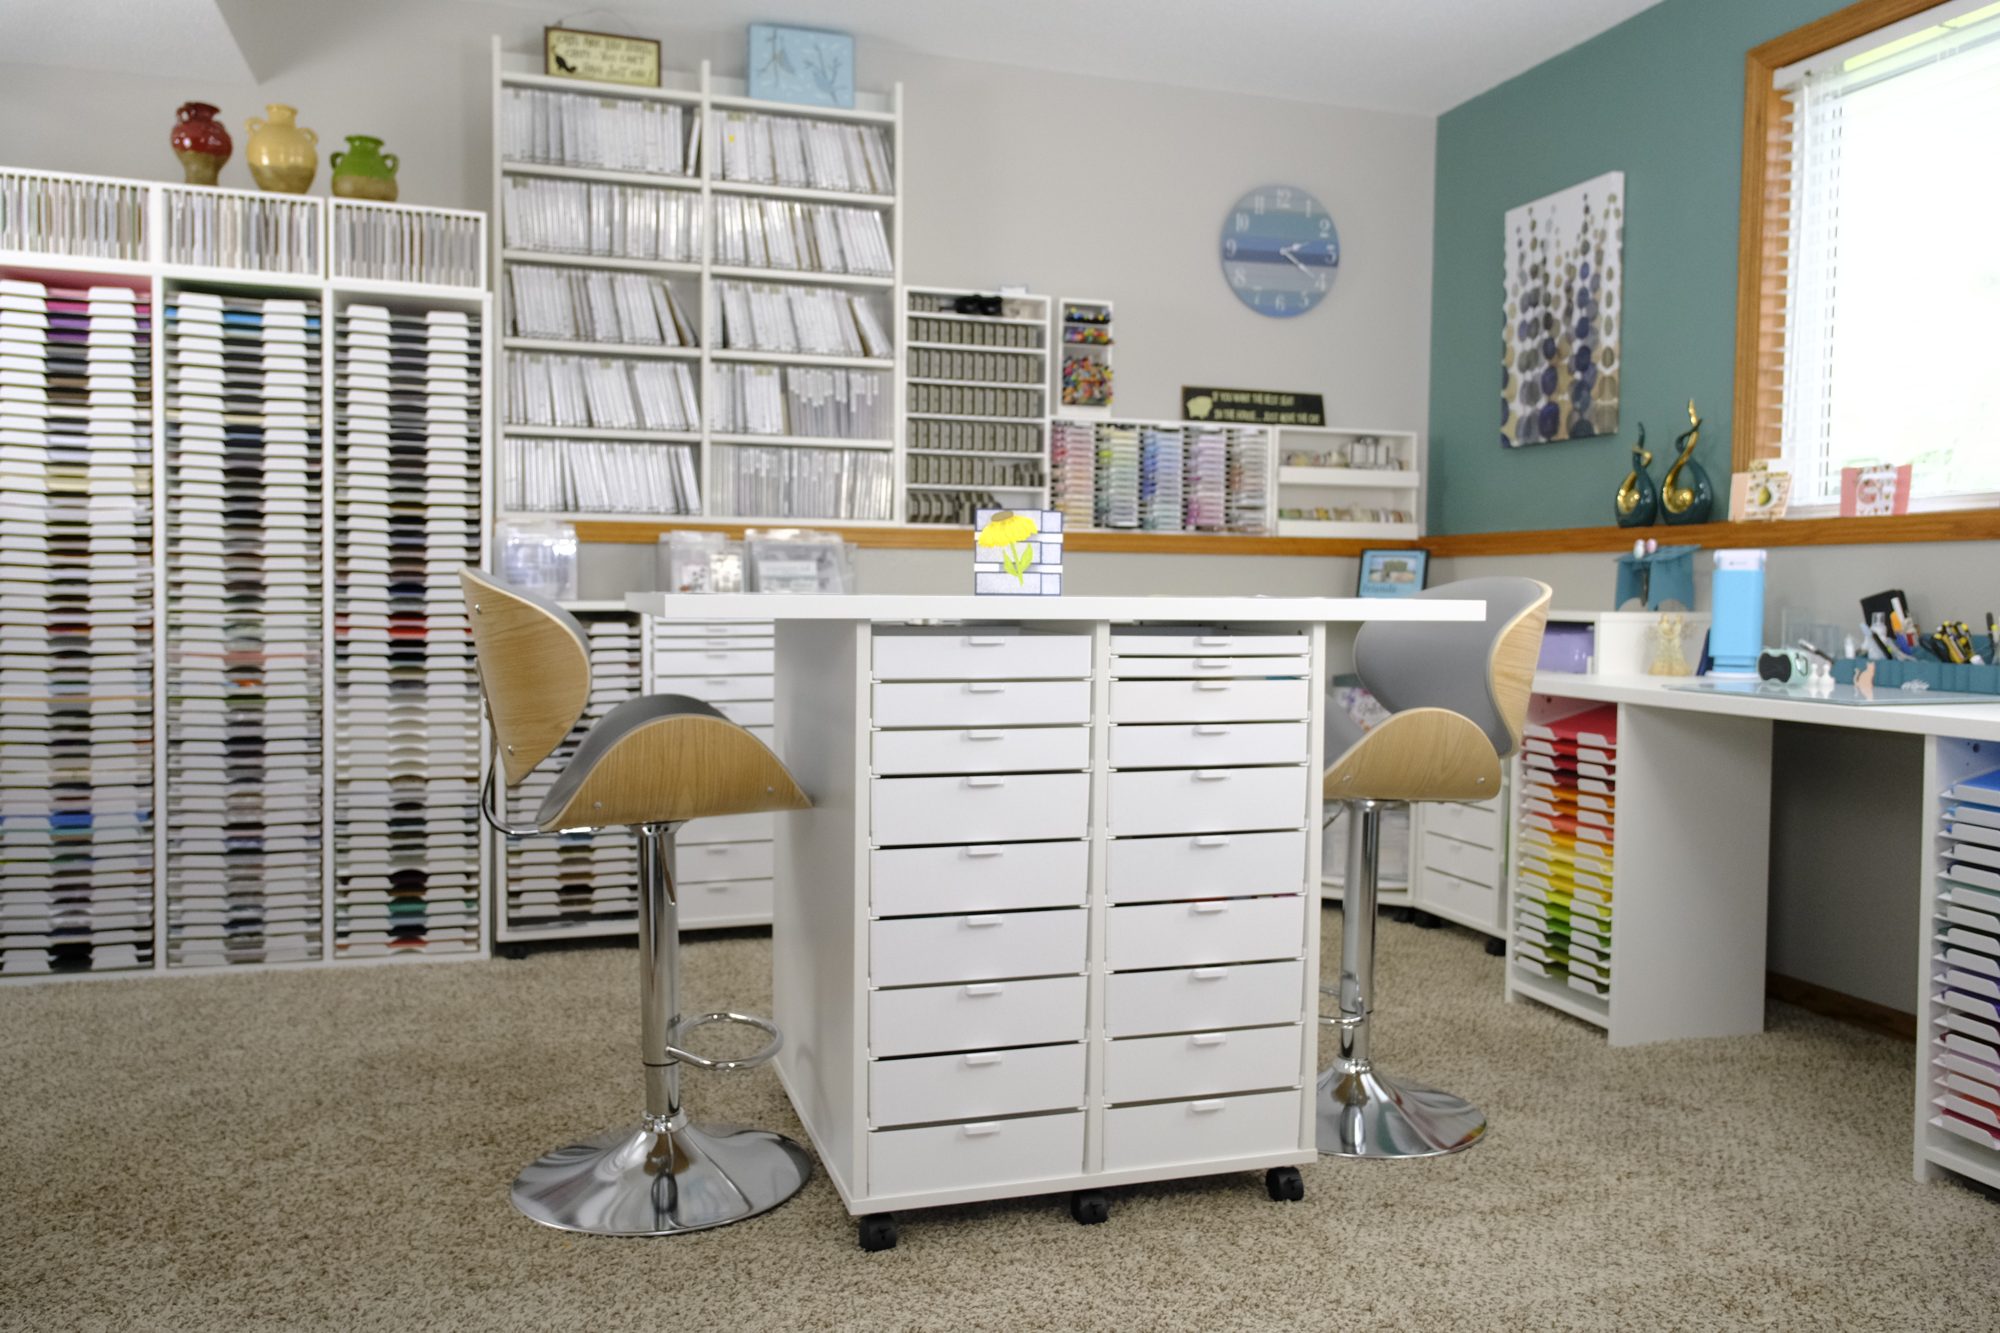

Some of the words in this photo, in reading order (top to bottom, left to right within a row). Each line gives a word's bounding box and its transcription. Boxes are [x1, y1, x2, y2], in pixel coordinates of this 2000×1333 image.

[1255, 195, 1265, 214] 11
[1276, 188, 1291, 208] 12
[1305, 200, 1311, 218] 1
[1235, 213, 1249, 232] 10
[1319, 219, 1330, 238] 2
[1225, 239, 1237, 257] 9
[1325, 244, 1336, 264] 3
[1234, 268, 1246, 286] 8
[1315, 273, 1326, 292] 4
[1252, 286, 1262, 305] 7
[1275, 294, 1286, 311] 6
[1298, 290, 1309, 308] 5
